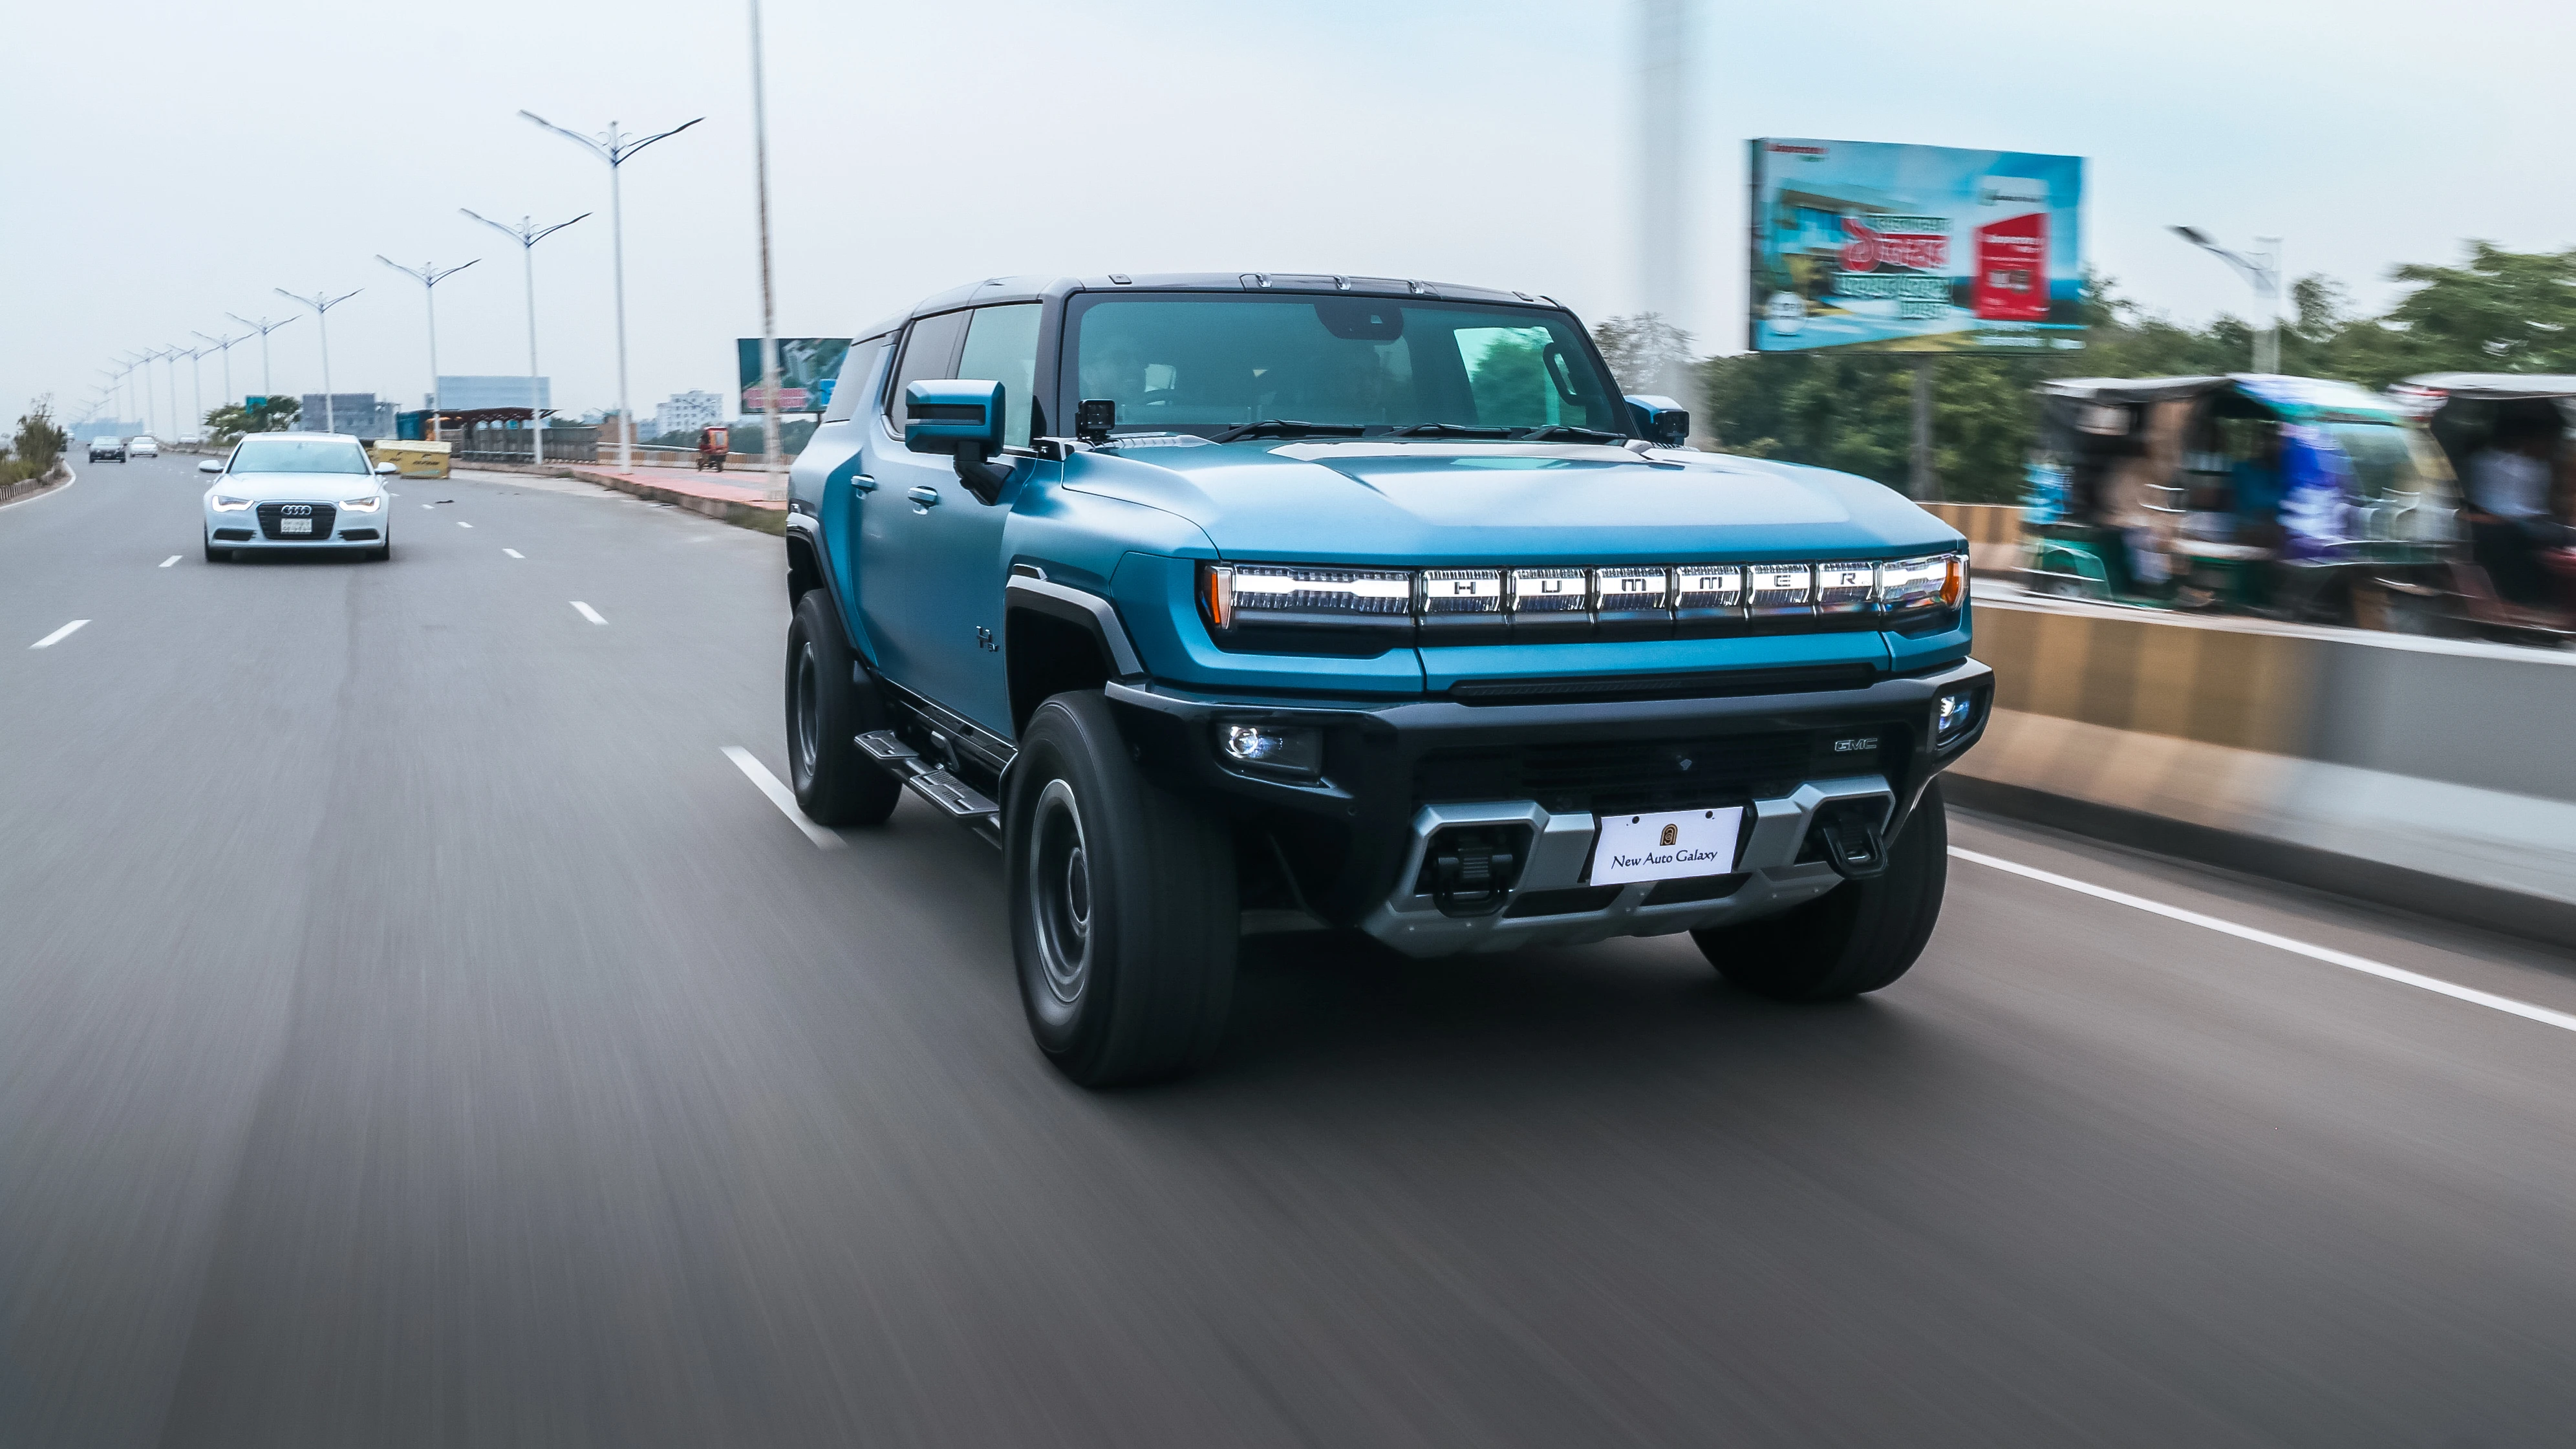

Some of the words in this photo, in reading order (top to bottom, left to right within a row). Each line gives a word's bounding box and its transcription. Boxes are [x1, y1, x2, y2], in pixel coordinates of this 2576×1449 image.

[1454, 572, 1856, 595] HUMMER
[1834, 738, 1878, 751] GMC
[1611, 855, 1642, 869] New
[1643, 852, 1673, 867] Auto
[1676, 849, 1718, 862] Galaxy
